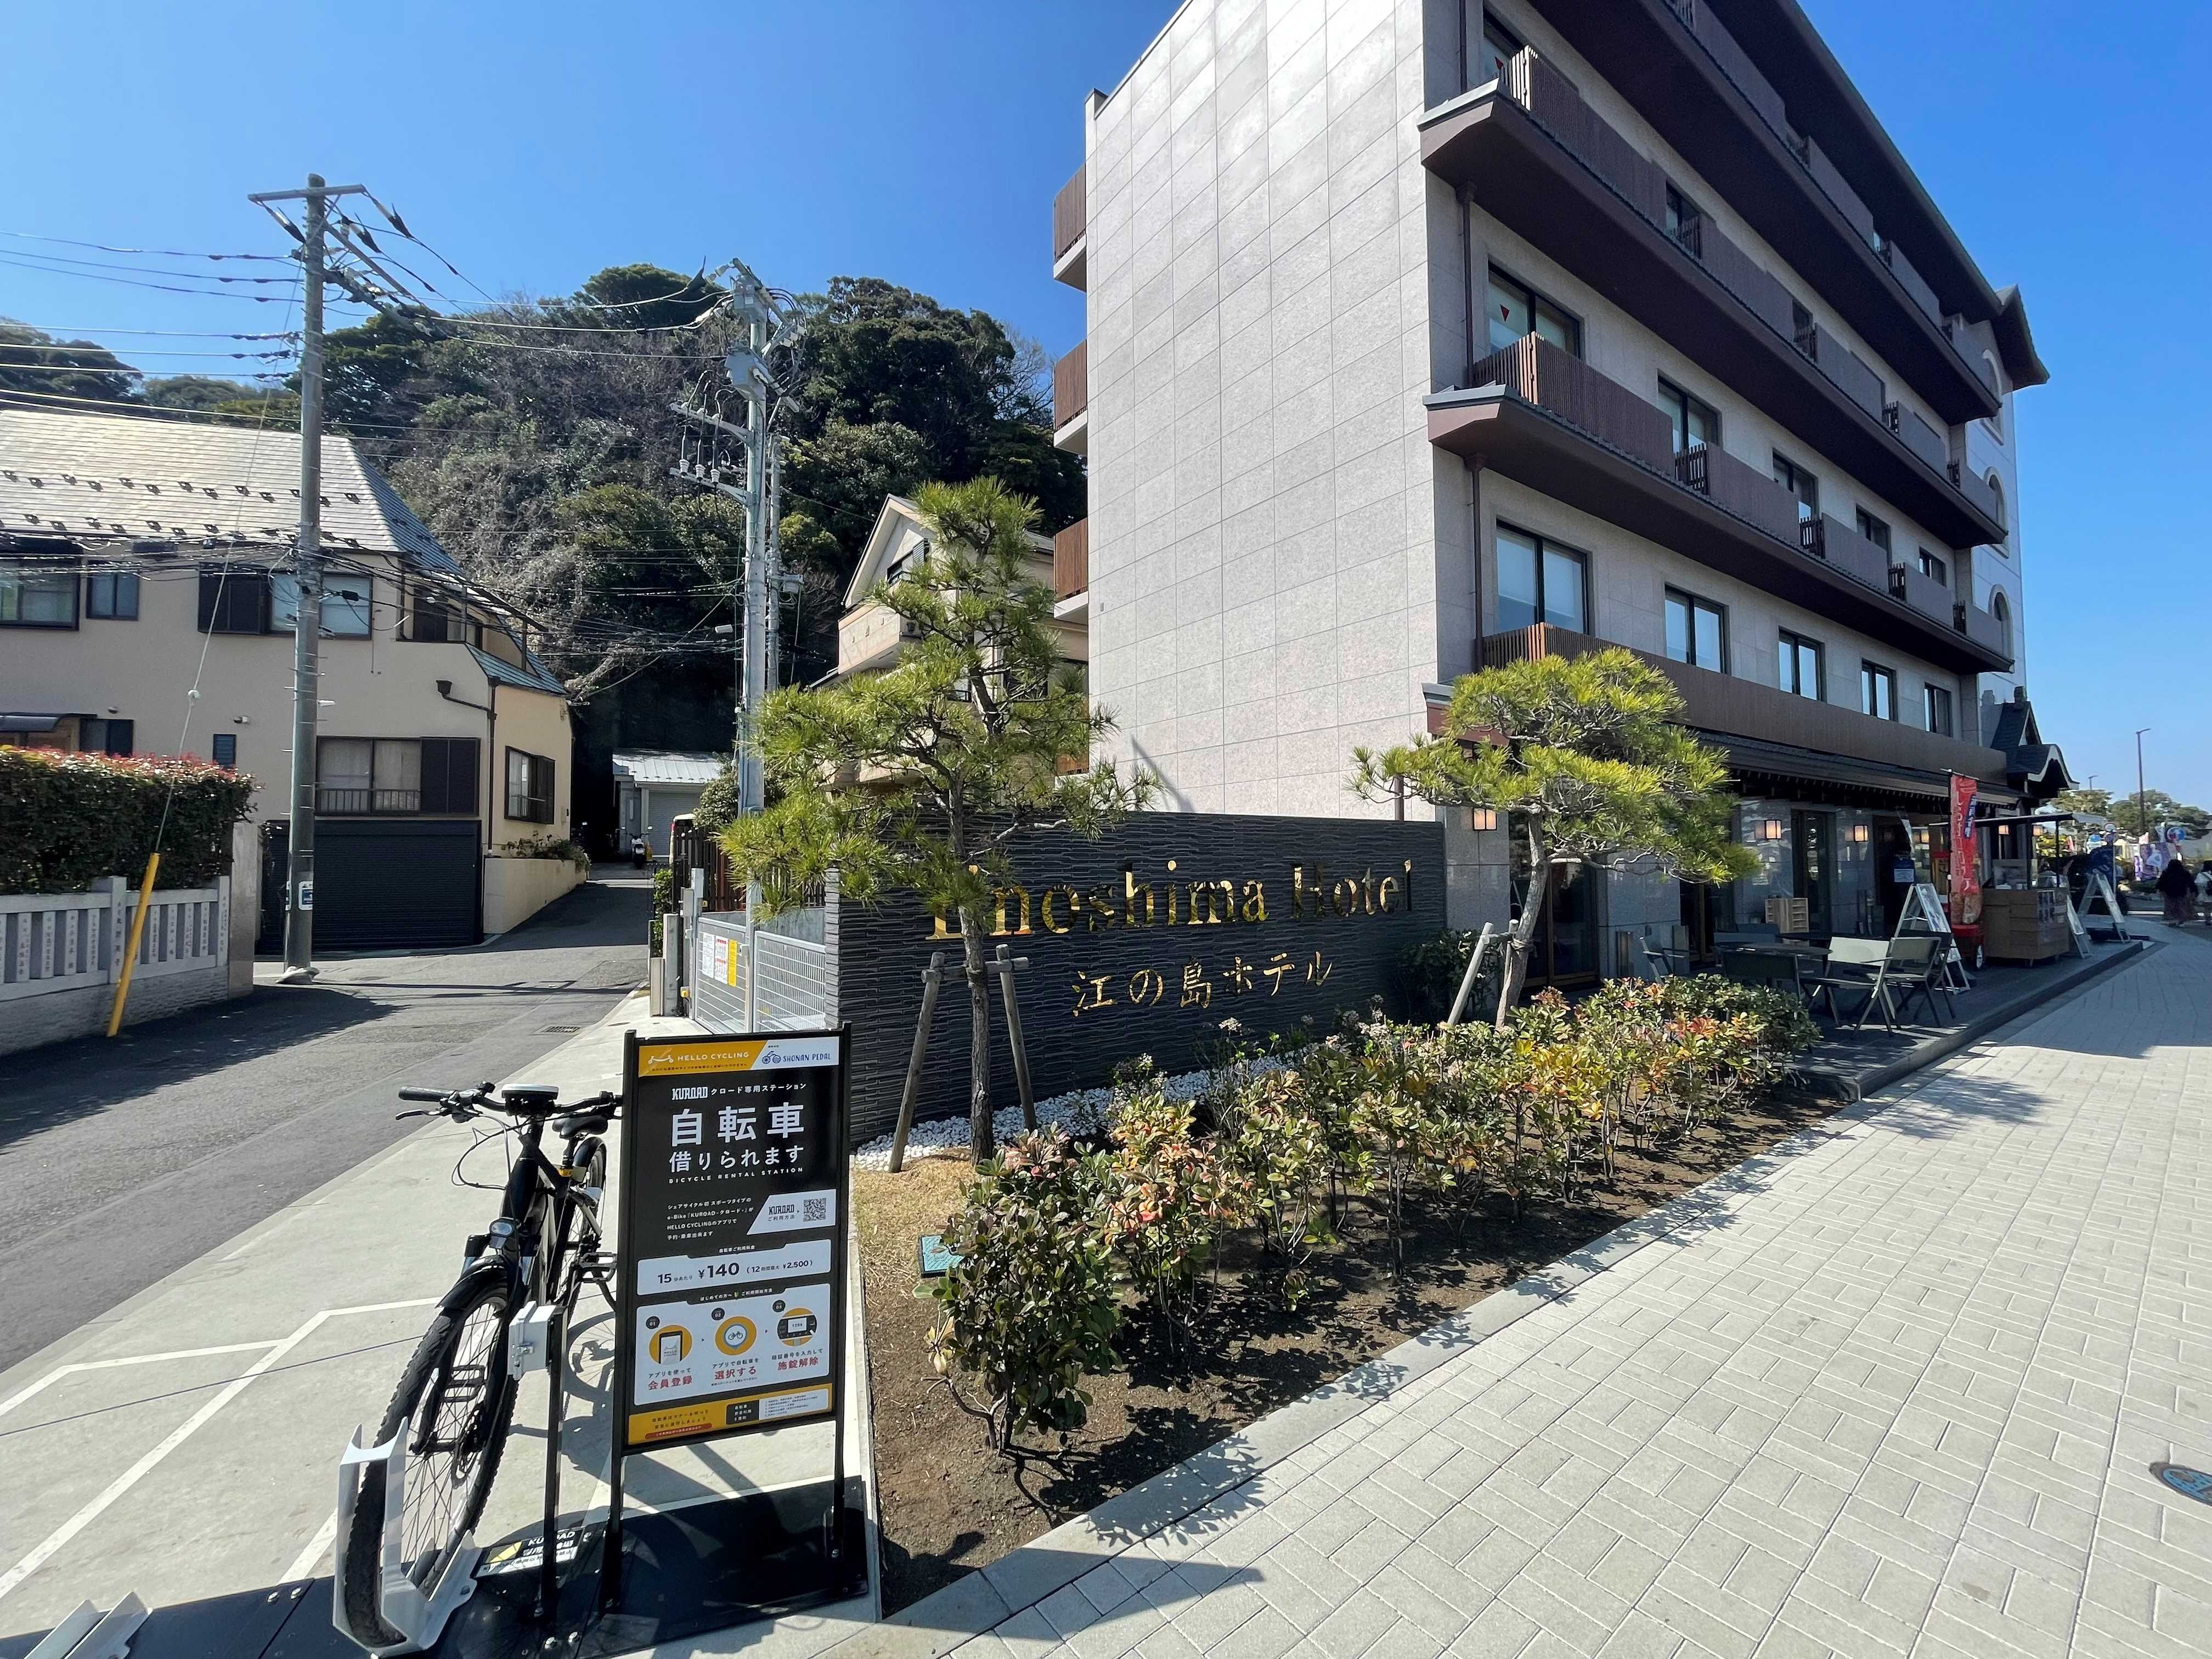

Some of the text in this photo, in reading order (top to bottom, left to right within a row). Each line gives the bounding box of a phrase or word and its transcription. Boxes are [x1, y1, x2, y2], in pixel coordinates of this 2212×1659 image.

[1290, 859, 1413, 920] Hotel
[1071, 951, 1333, 1017] 江の島ホテル
[710, 1051, 749, 1060] CYCLING
[783, 1053, 809, 1062] SHONAN
[672, 1083, 806, 1101] KUROAD クロード専用ステーション
[672, 1102, 804, 1147] 自転車
[669, 1145, 804, 1173] 借りられます
[669, 1167, 803, 1184] BICYCLE RENTAL STATION
[768, 1204, 795, 1215] KUROAD
[686, 1218, 737, 1229] CYCLINGのアプリで
[698, 1262, 740, 1279] ¥140
[712, 1357, 759, 1369] アプリで自転車を
[777, 1356, 819, 1370] 施錠解除
[648, 1367, 692, 1379] アプリを使って
[714, 1365, 757, 1380] 選択する
[648, 1375, 693, 1390] 会員登録
[527, 1531, 575, 1547] KUAD
